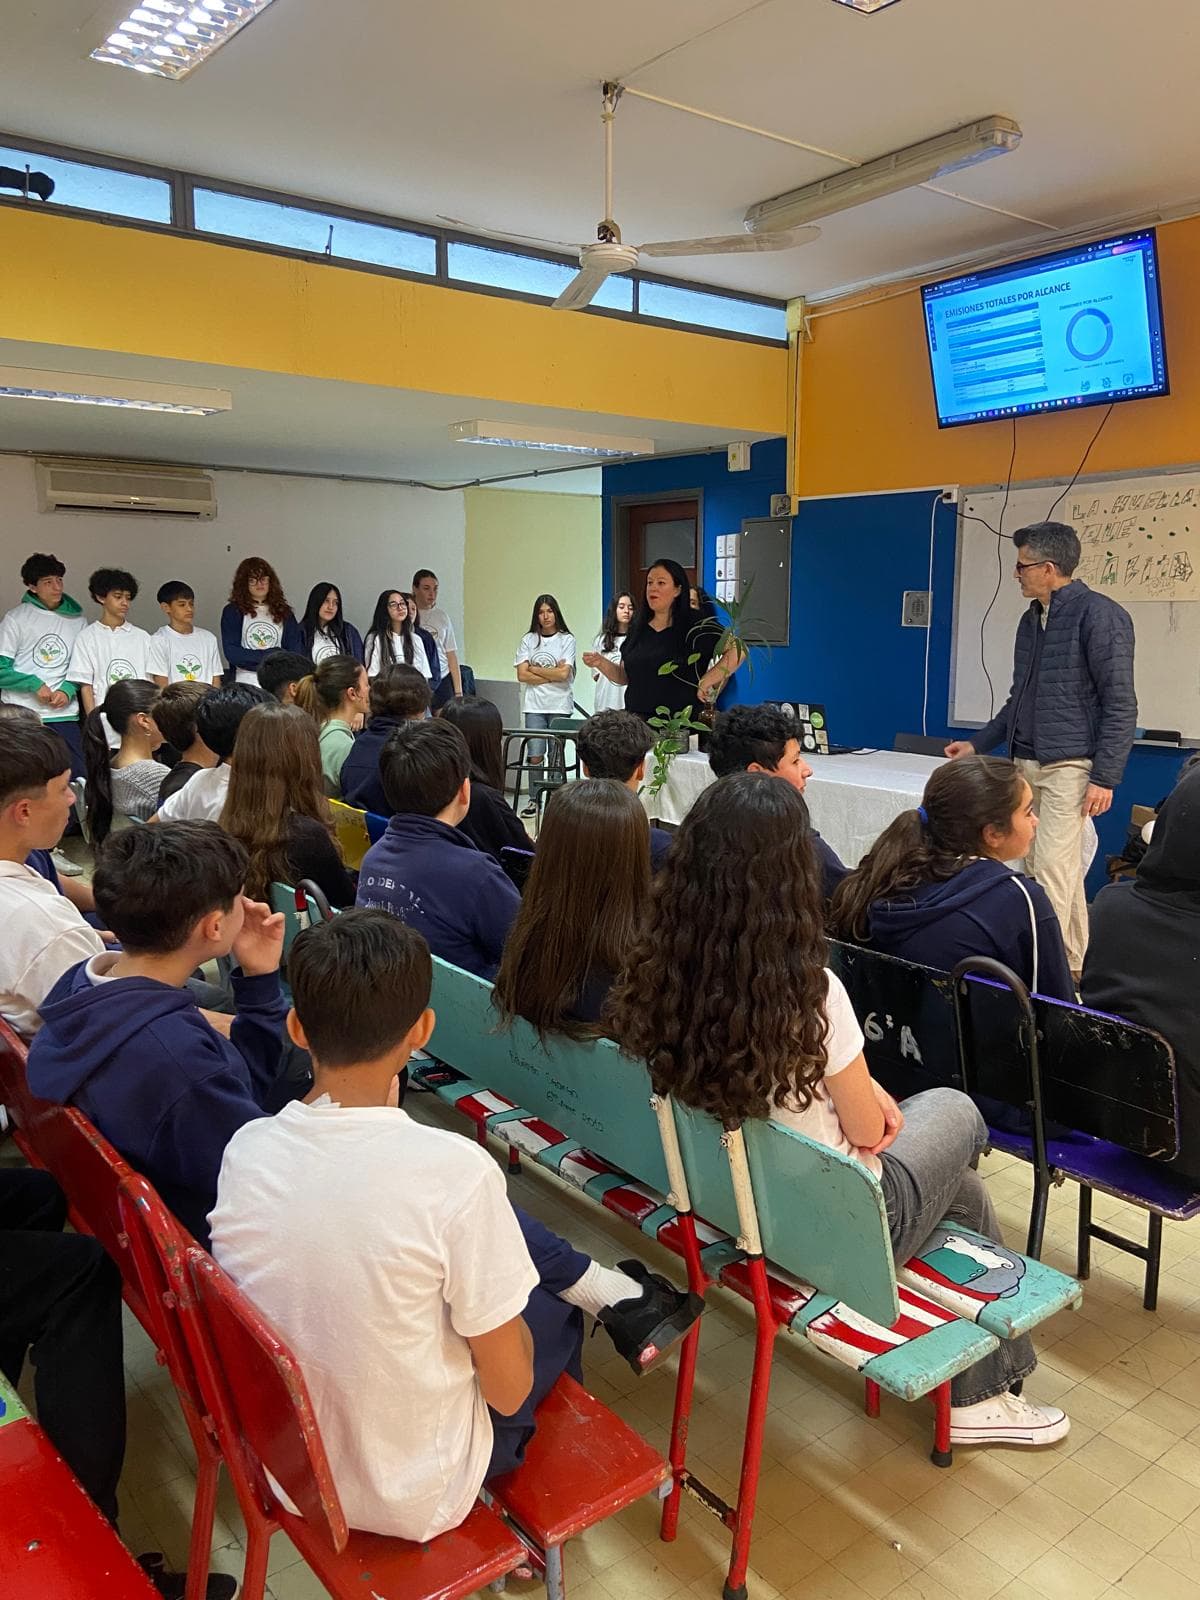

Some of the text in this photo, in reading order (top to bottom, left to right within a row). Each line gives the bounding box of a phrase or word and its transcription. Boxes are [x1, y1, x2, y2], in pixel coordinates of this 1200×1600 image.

[945, 281, 1071, 319] EMISIONES TOTALES POR ALCANCE
[1072, 488, 1194, 520] LA HUELLA
[900, 1025, 924, 1065] A
